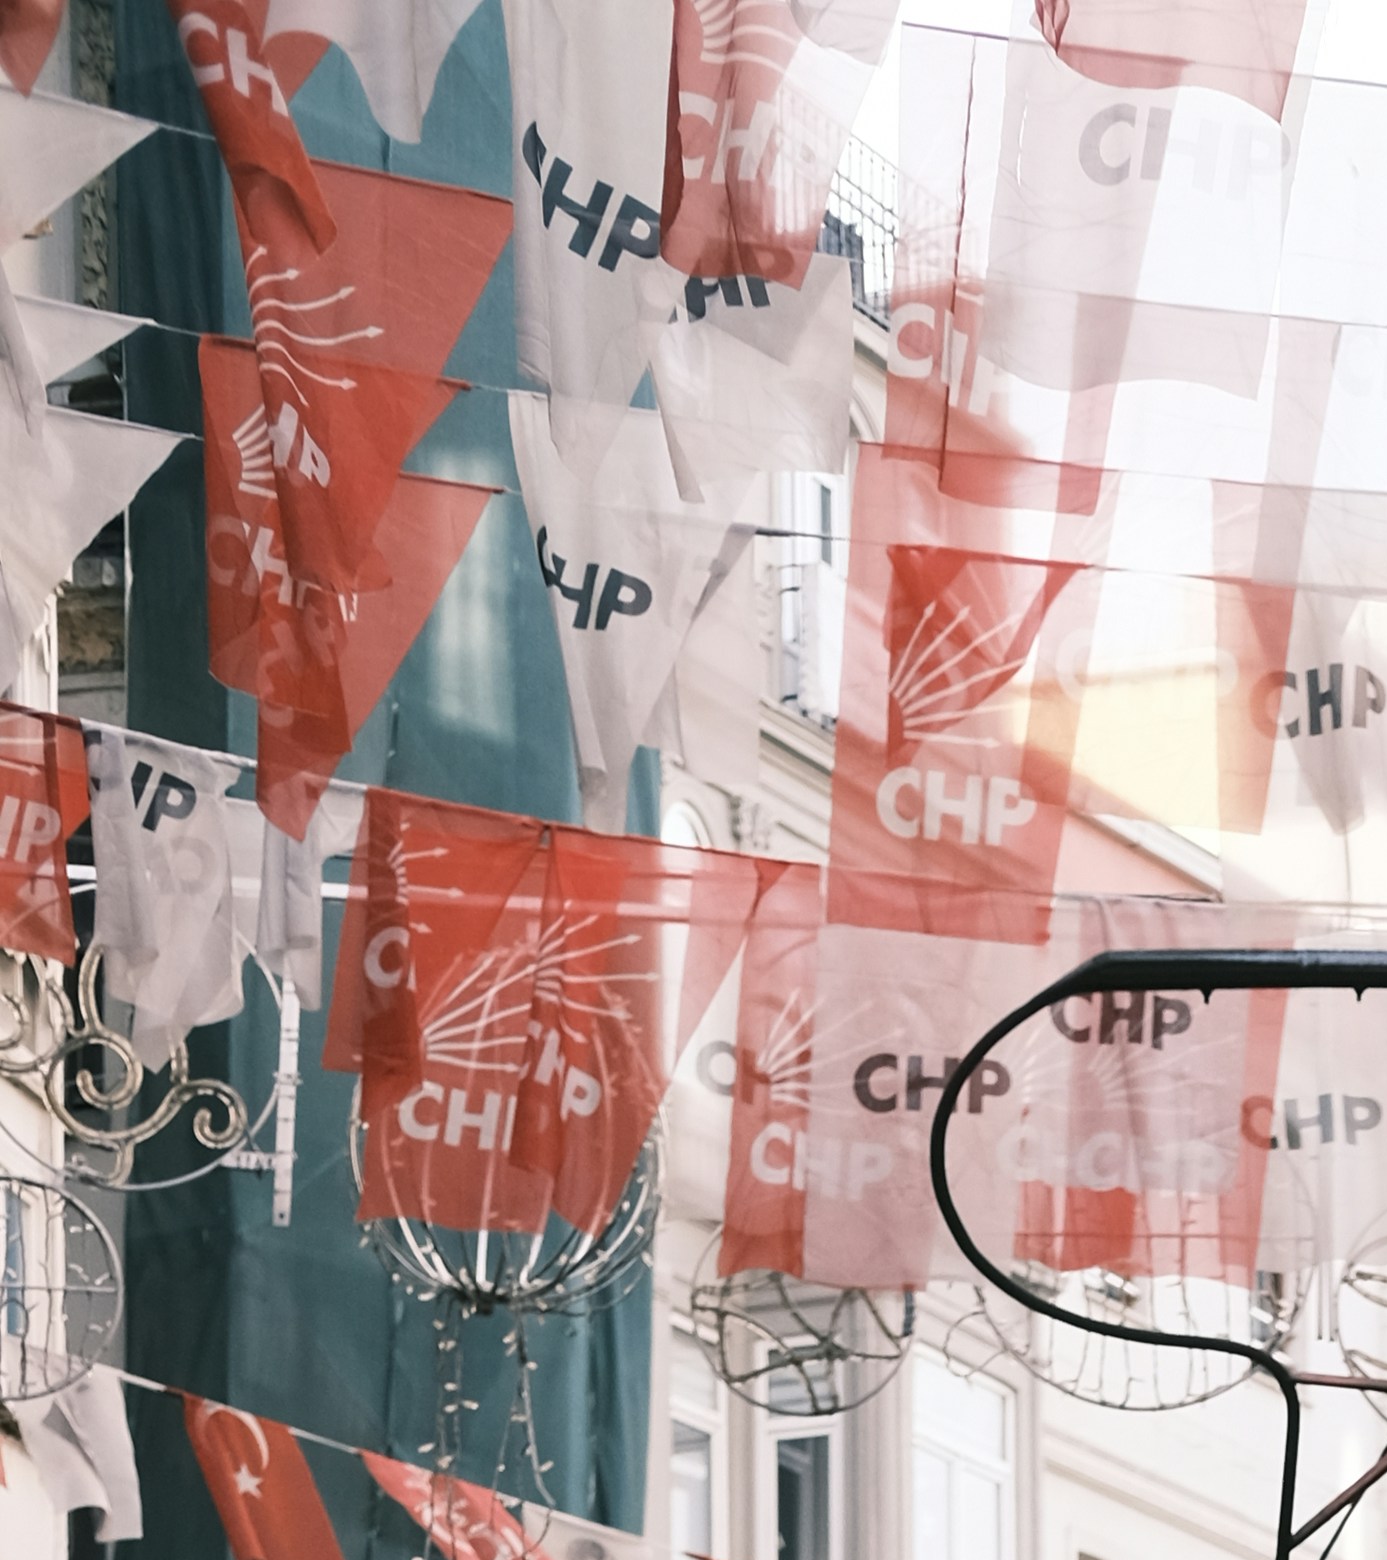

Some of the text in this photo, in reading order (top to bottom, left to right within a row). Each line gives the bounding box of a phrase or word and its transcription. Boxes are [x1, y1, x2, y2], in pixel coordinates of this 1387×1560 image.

[1250, 662, 1387, 740] CHP
[876, 768, 1038, 846] CHP
[1050, 995, 1193, 1050] CHP
[853, 1052, 1013, 1116] CHP
[1240, 1095, 1383, 1150] CHP
[751, 1122, 893, 1201] CHP
